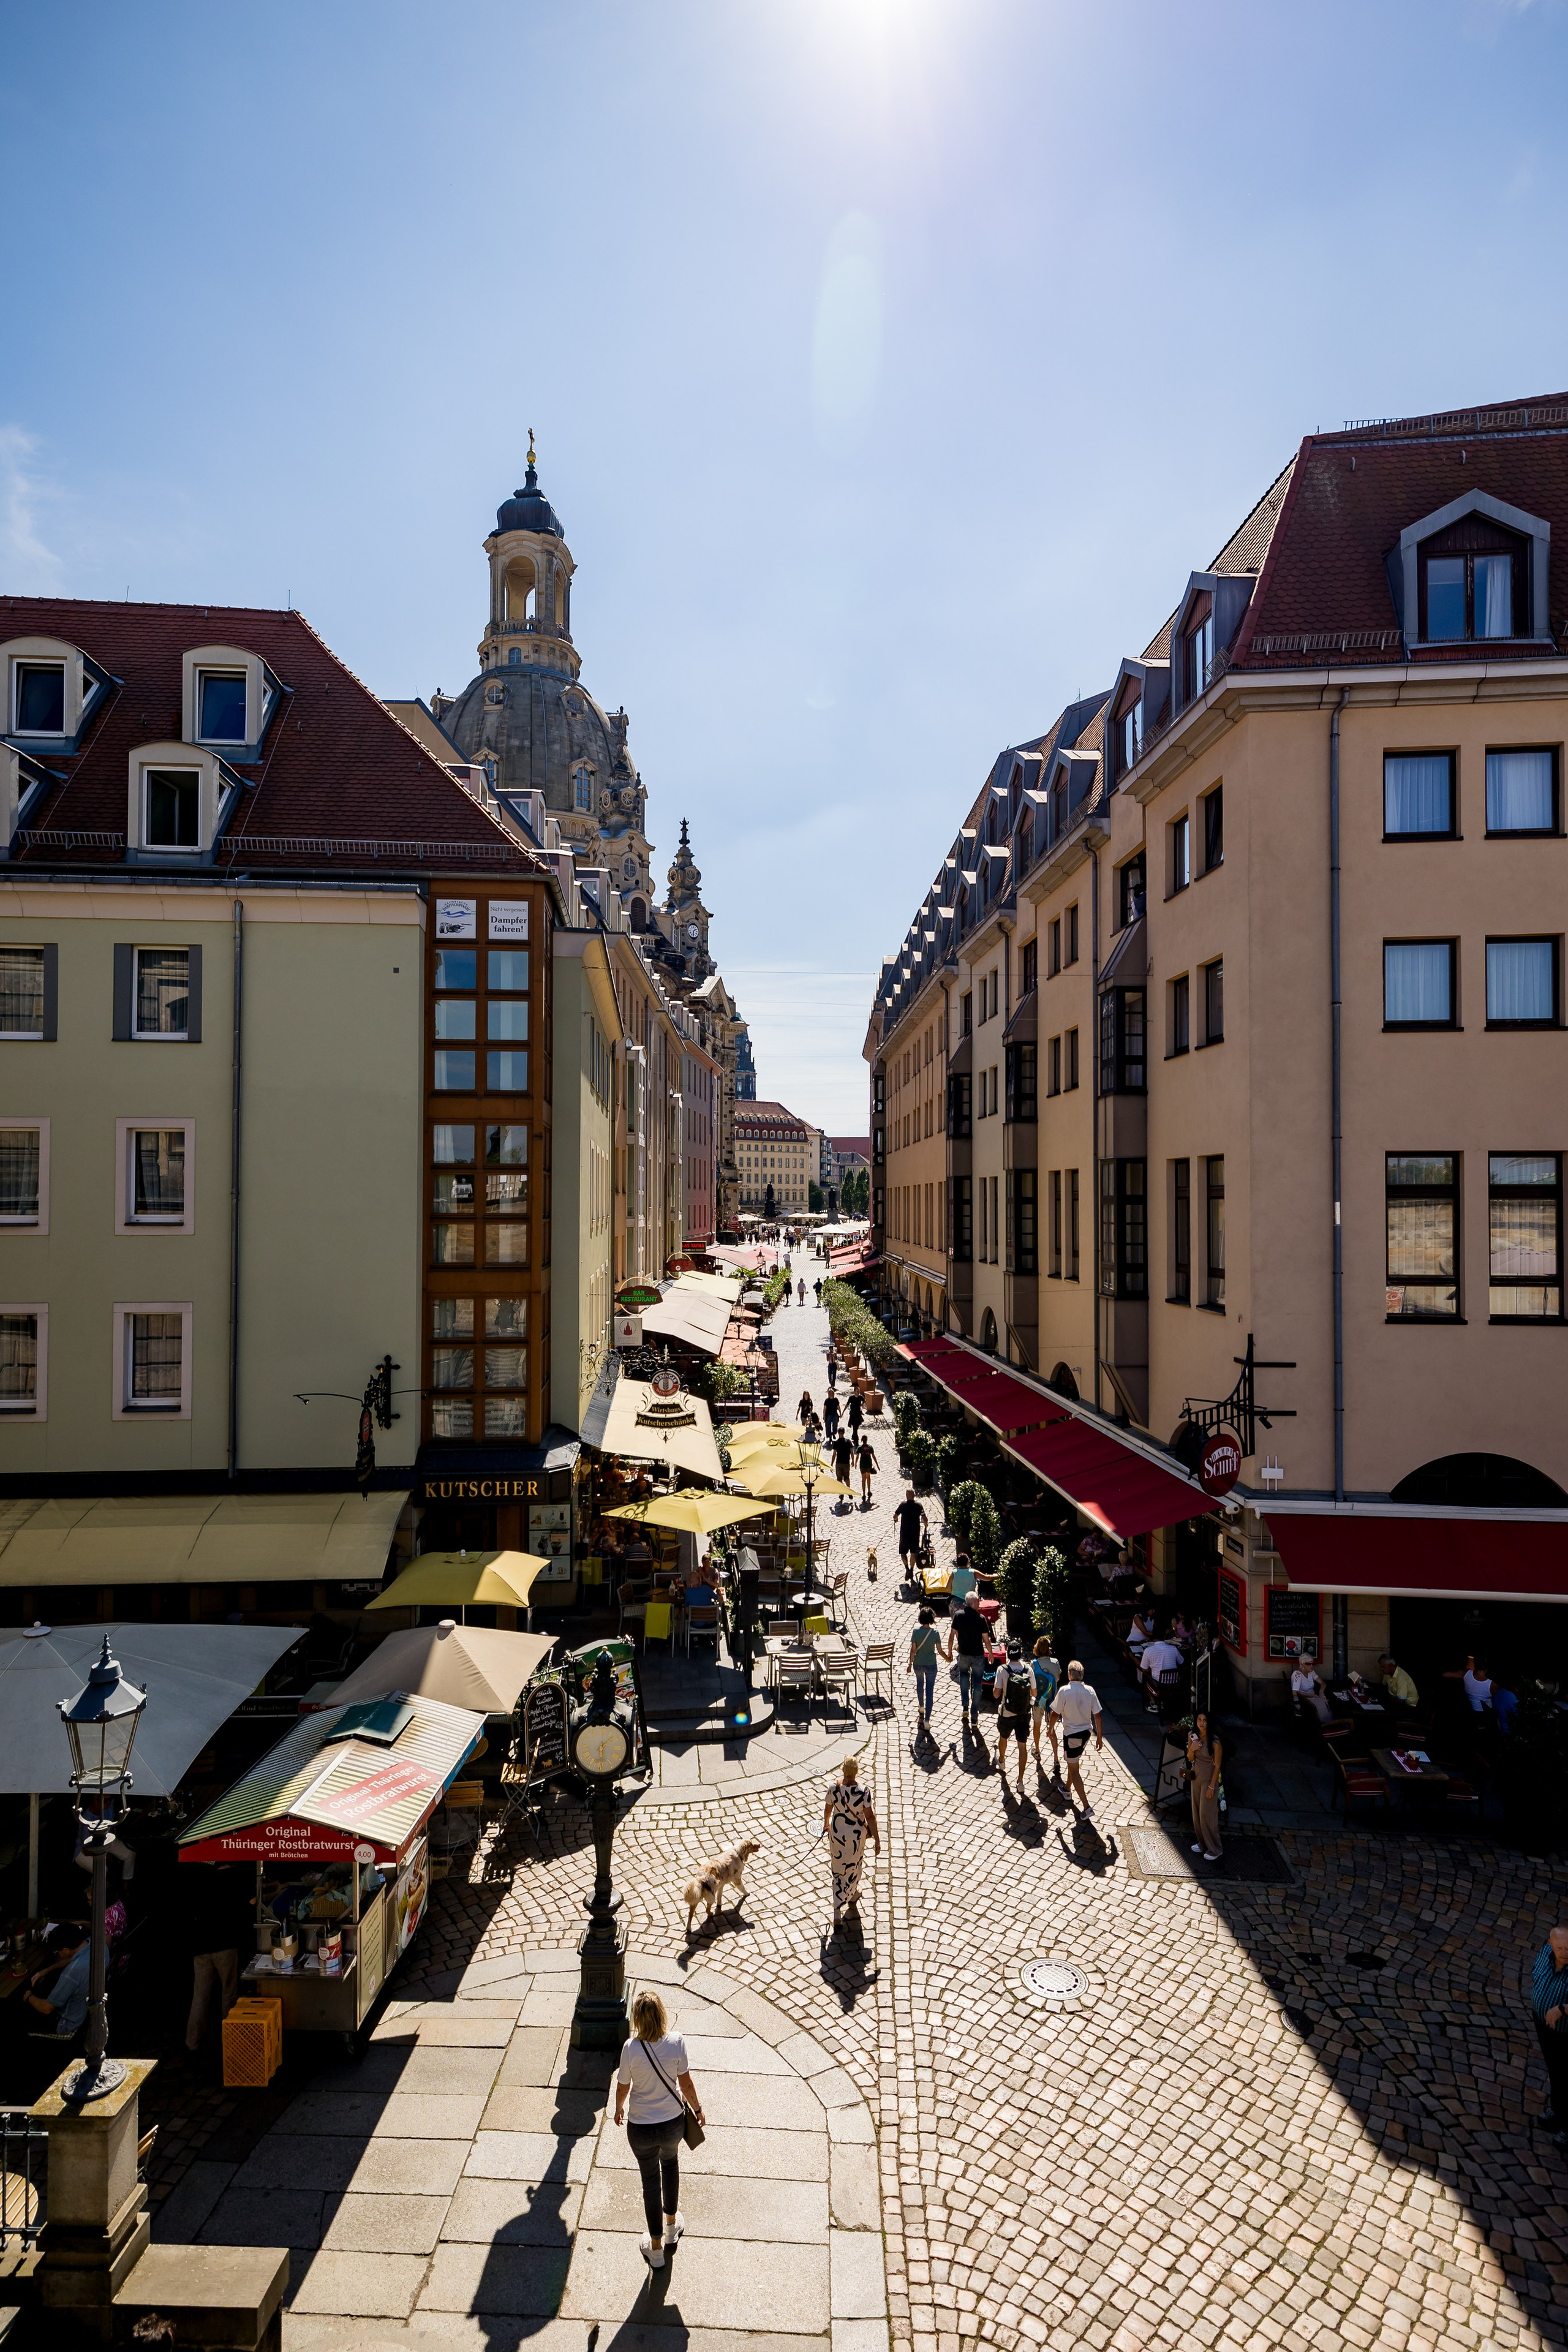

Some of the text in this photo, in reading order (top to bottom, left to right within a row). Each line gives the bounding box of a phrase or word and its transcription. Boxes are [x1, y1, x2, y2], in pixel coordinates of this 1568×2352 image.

[654, 1374, 677, 1383] ERDINGER
[638, 1416, 694, 1427] Kutscherschänke
[1212, 1448, 1234, 1461] DAMPF
[425, 1480, 538, 1497] KUTSCHER
[536, 1697, 554, 1705] Kuchen
[528, 1706, 543, 1717] (Apfel,
[328, 1765, 416, 1809] Original Thüringer
[343, 1772, 432, 1819] Rostbratwurst
[266, 1826, 311, 1838] Original
[221, 1839, 355, 1850] Thüringer Rostbratwurst
